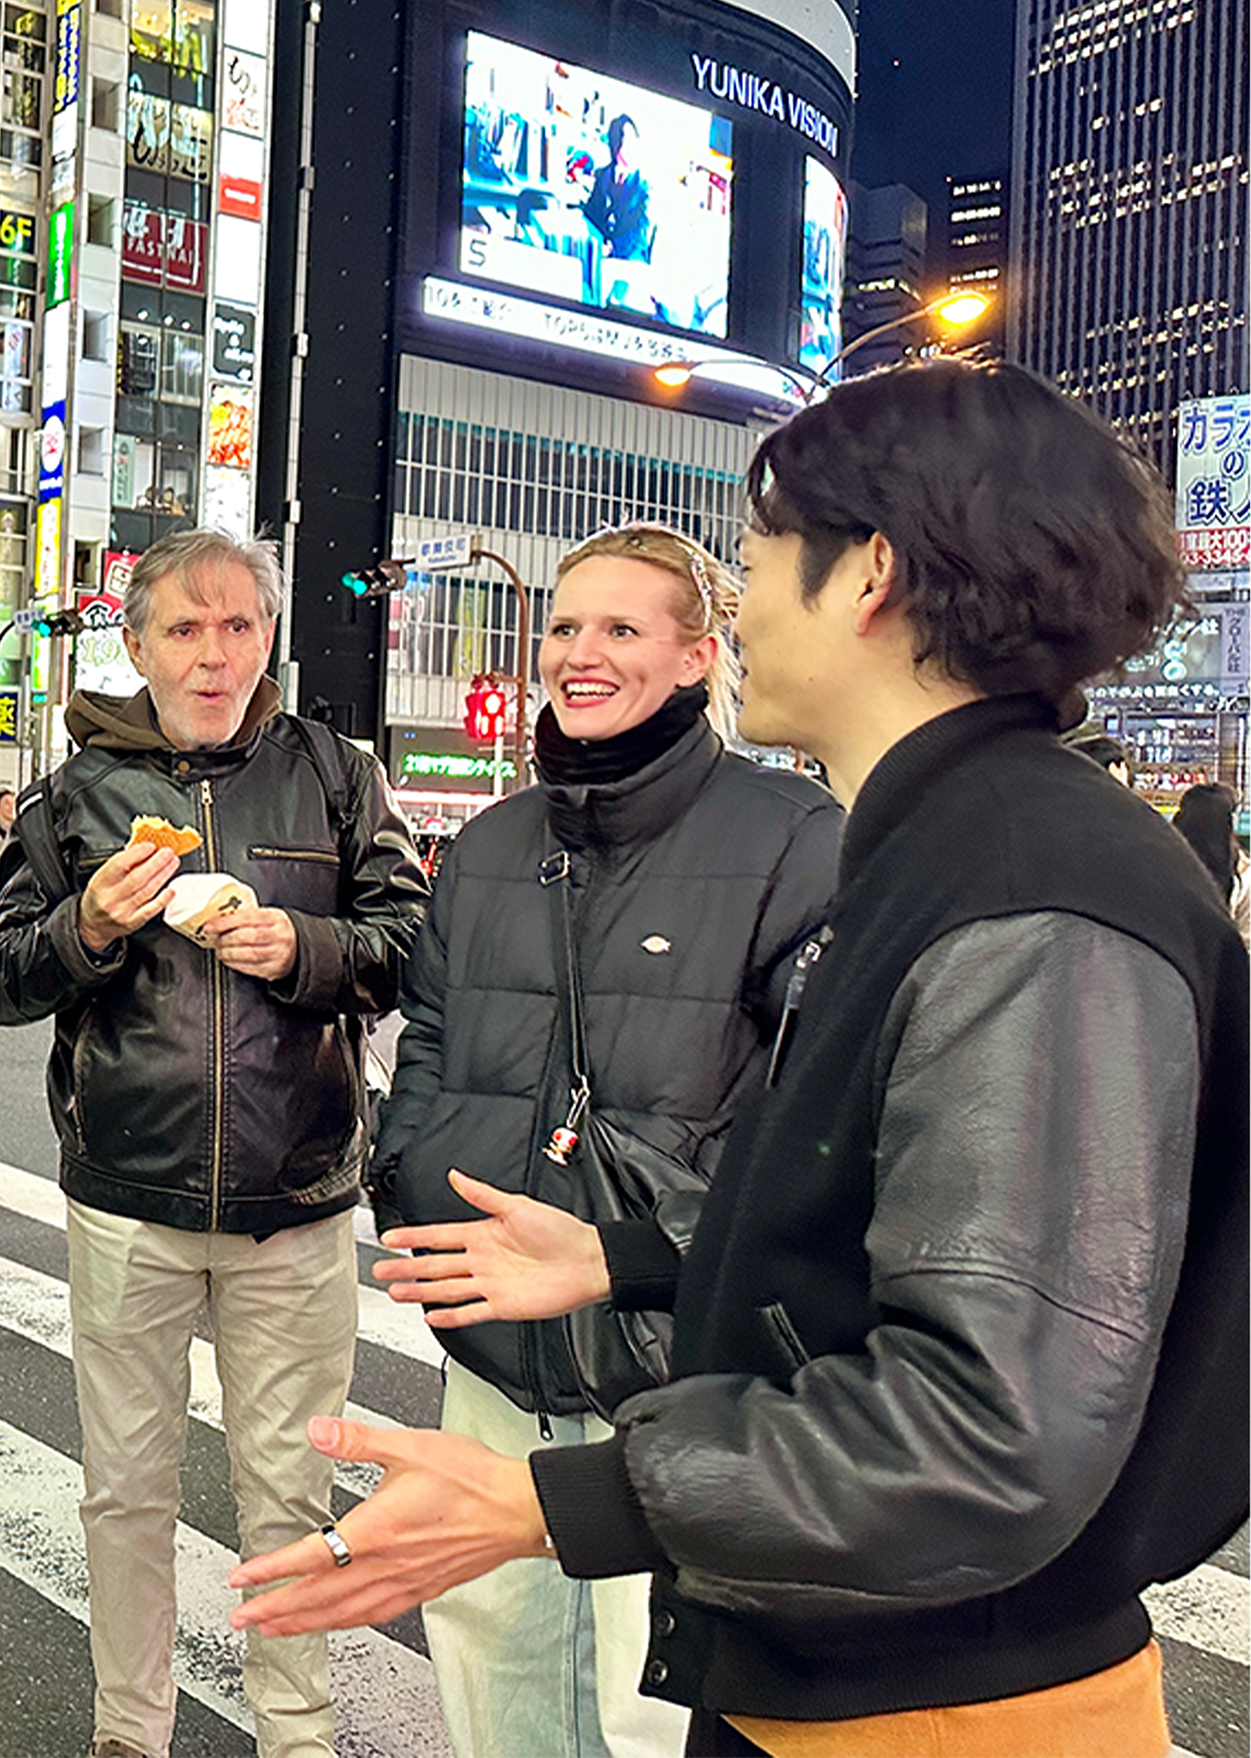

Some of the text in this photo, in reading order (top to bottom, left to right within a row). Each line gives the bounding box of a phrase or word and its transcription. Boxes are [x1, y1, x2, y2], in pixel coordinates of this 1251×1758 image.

[692, 53, 838, 158] YUNIKA VISION
[0, 214, 32, 246] 6F
[1223, 451, 1245, 475] の
